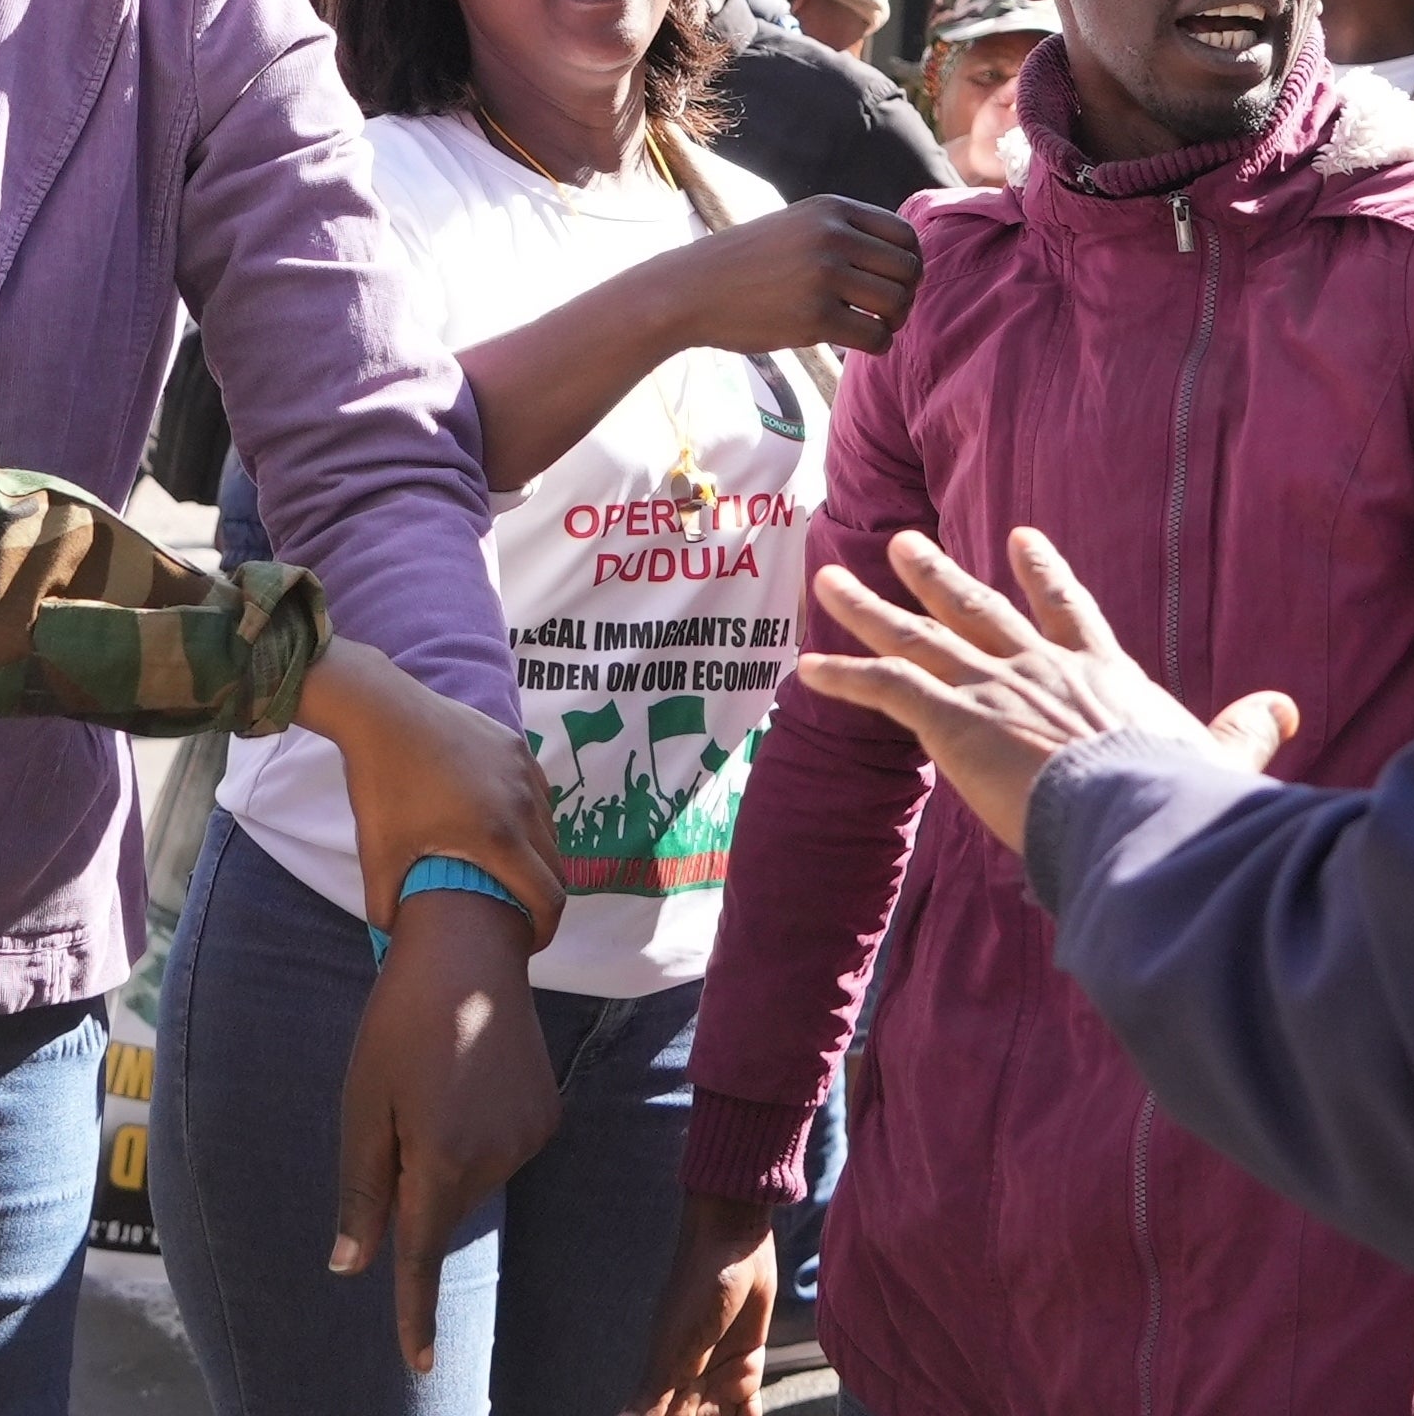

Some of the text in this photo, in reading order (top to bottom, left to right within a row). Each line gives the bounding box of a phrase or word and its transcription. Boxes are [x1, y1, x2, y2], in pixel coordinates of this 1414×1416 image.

[593, 544, 759, 586] DUDULA
[594, 617, 747, 651] IMMIGRANTS
[749, 618, 780, 648] ARE
[780, 618, 790, 647] A
[607, 661, 641, 692] ON
[642, 660, 687, 691] OUR
[692, 660, 782, 691] ECONOMY
